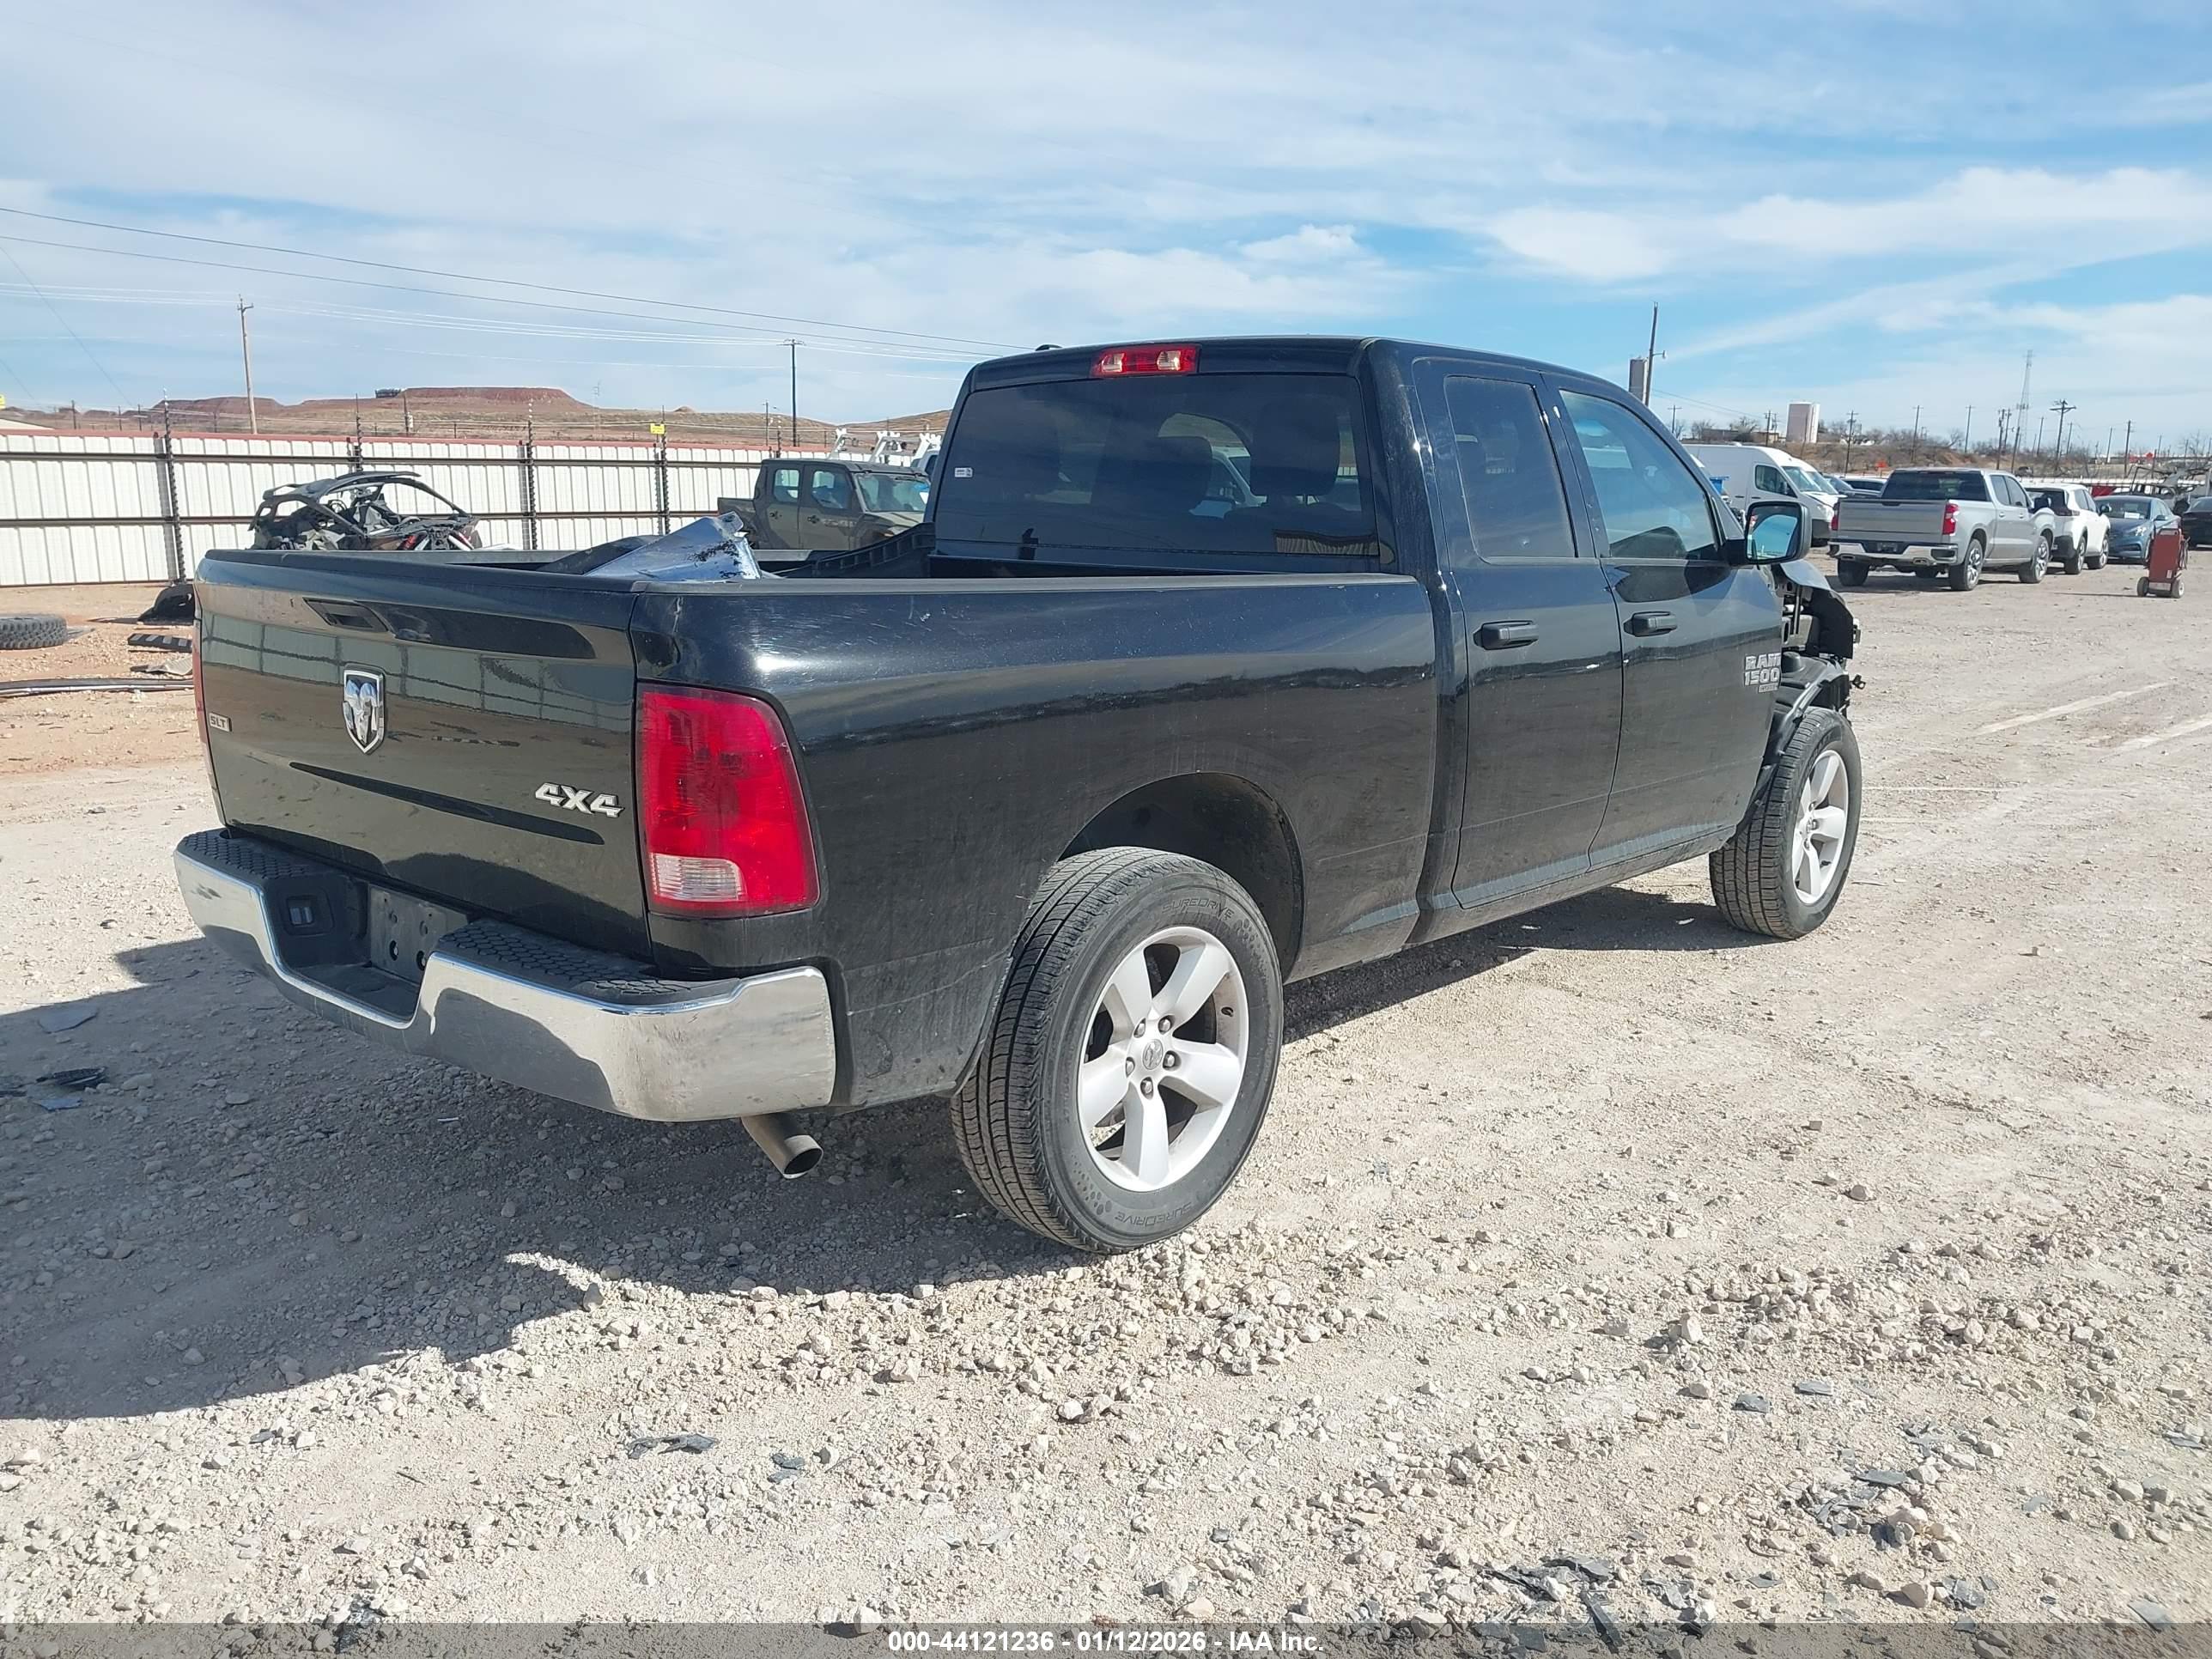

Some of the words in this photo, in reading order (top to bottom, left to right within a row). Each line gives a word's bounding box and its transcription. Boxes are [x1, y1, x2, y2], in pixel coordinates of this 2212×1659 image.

[1745, 653, 1781, 671] RAM
[1744, 668, 1780, 686] 1500
[210, 715, 227, 728] SLT
[1162, 898, 1235, 921] SUREDRIVE
[1115, 1201, 1193, 1227] SUREDRIVE
